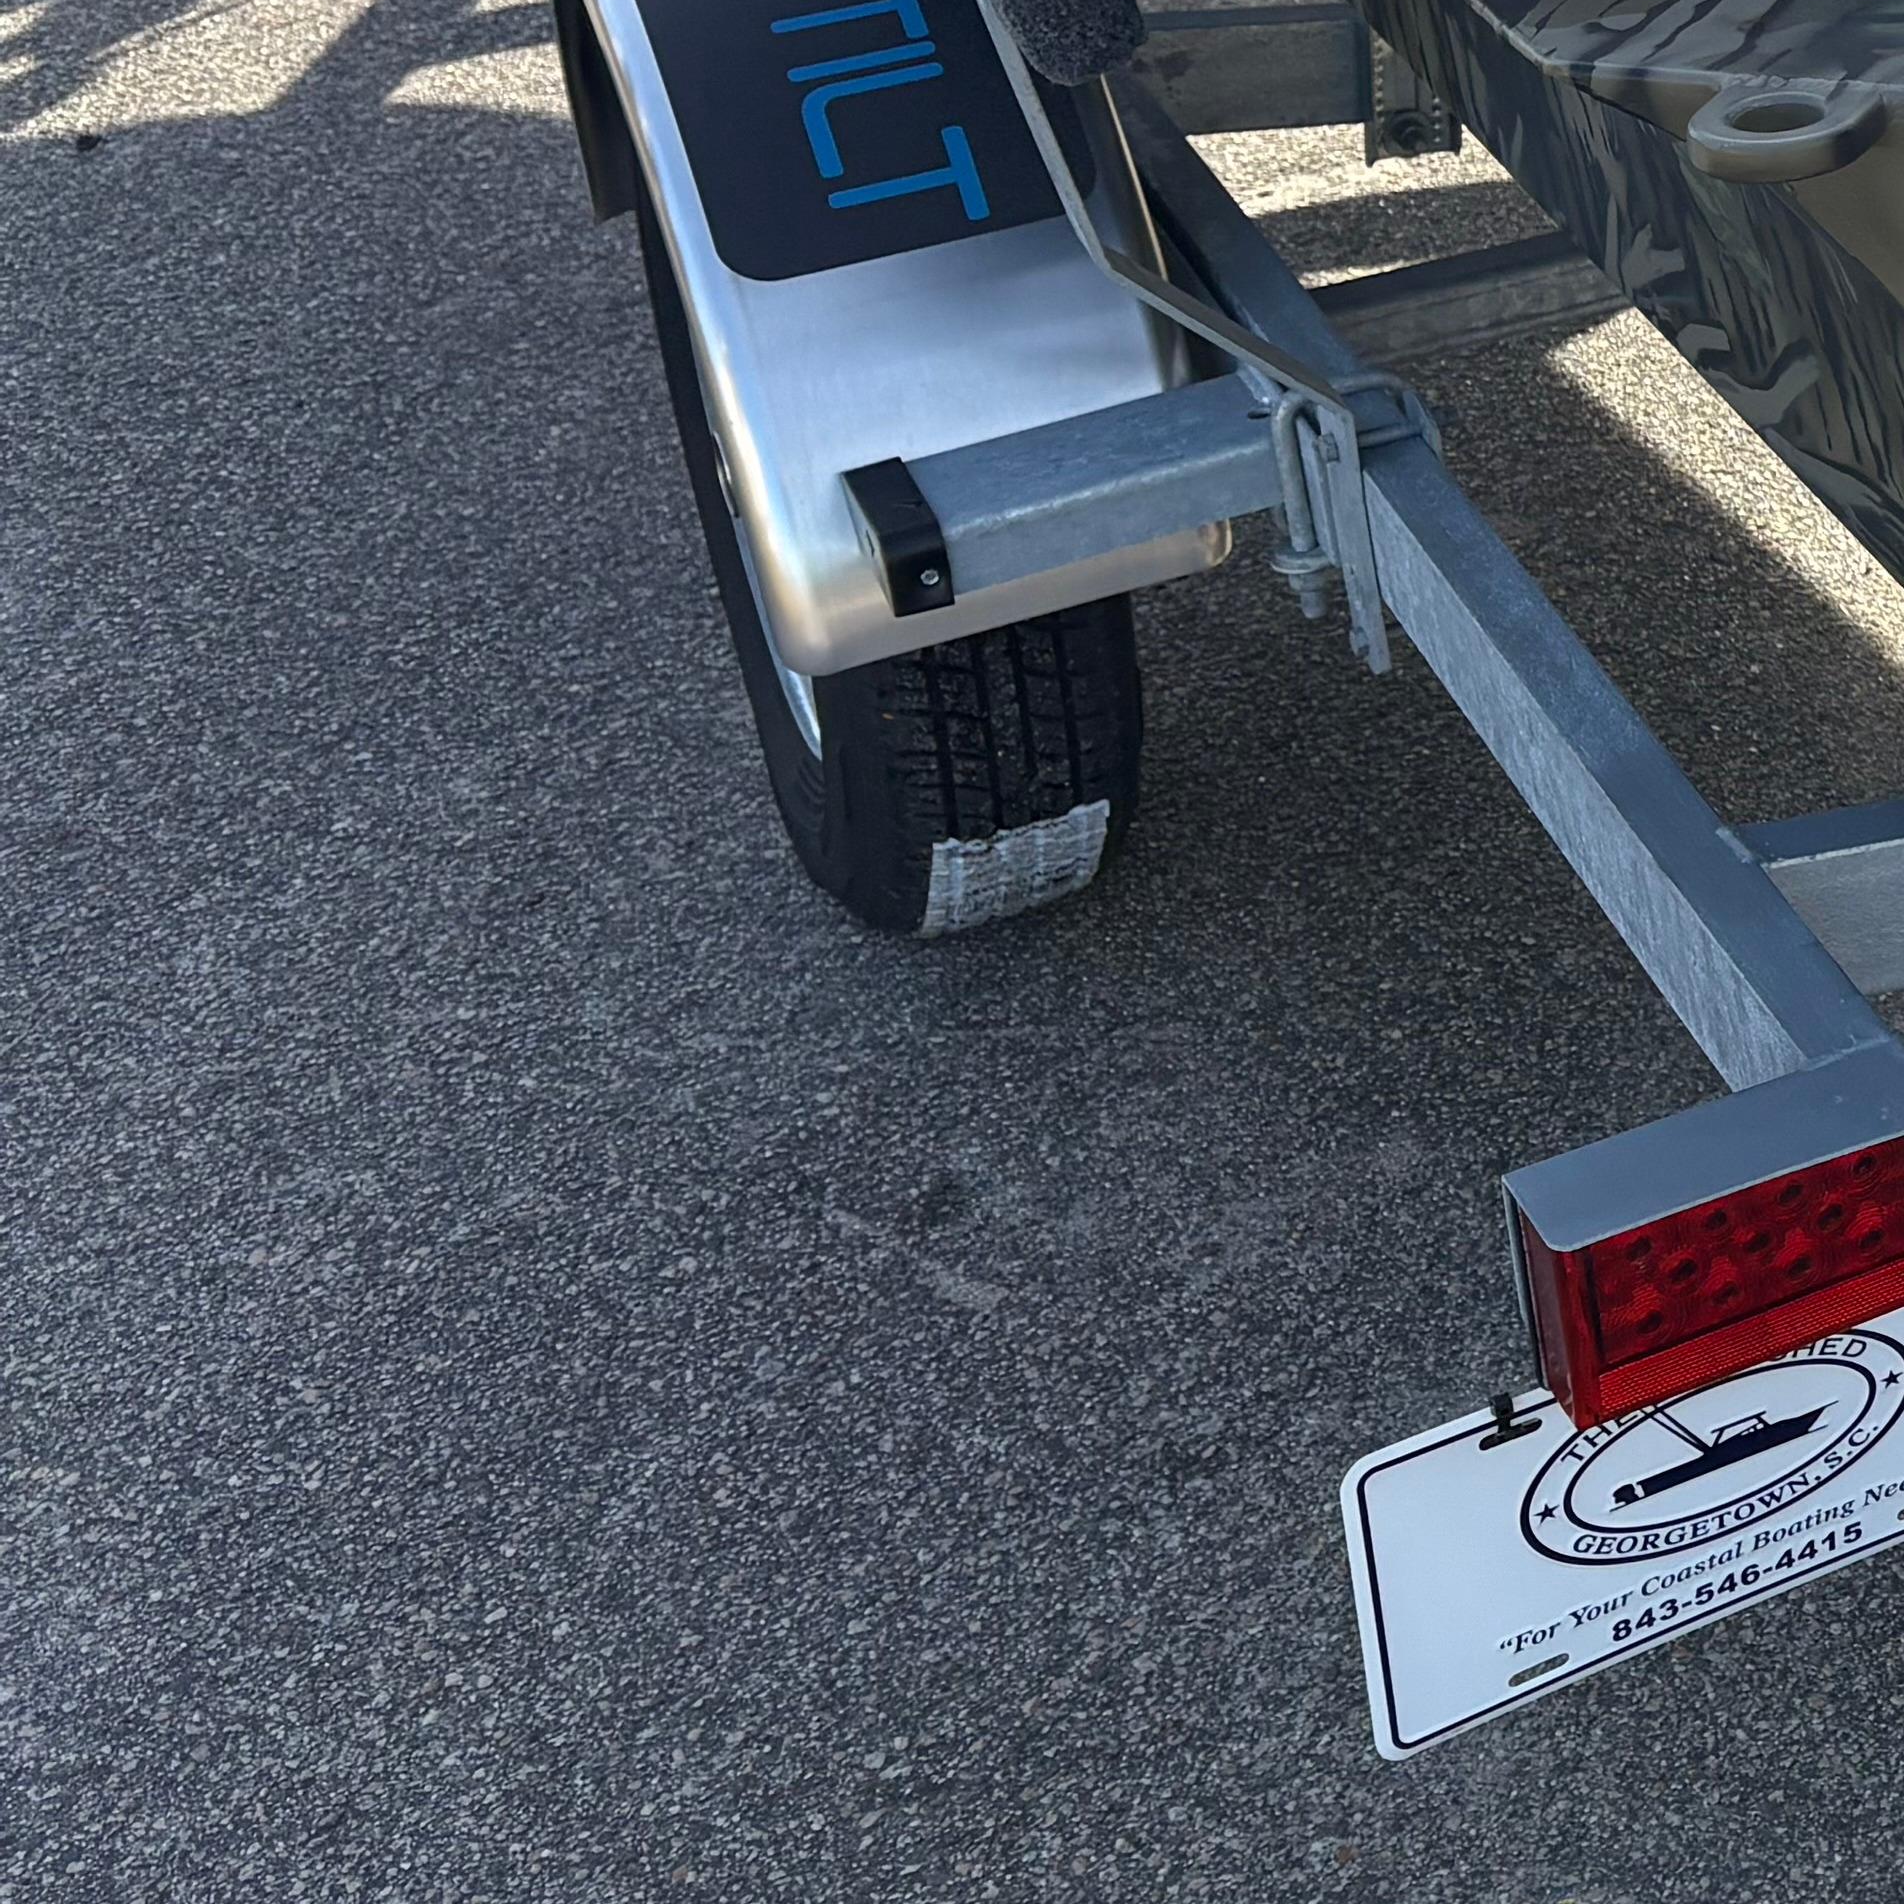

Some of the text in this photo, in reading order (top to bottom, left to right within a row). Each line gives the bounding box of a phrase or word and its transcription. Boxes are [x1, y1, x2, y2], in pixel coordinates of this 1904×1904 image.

[1569, 1593, 1633, 1626] Your
[1641, 1545, 1745, 1597] Coastal
[1753, 1499, 1854, 1550] Boating
[1612, 1521, 1863, 1642] 843-546-4415
